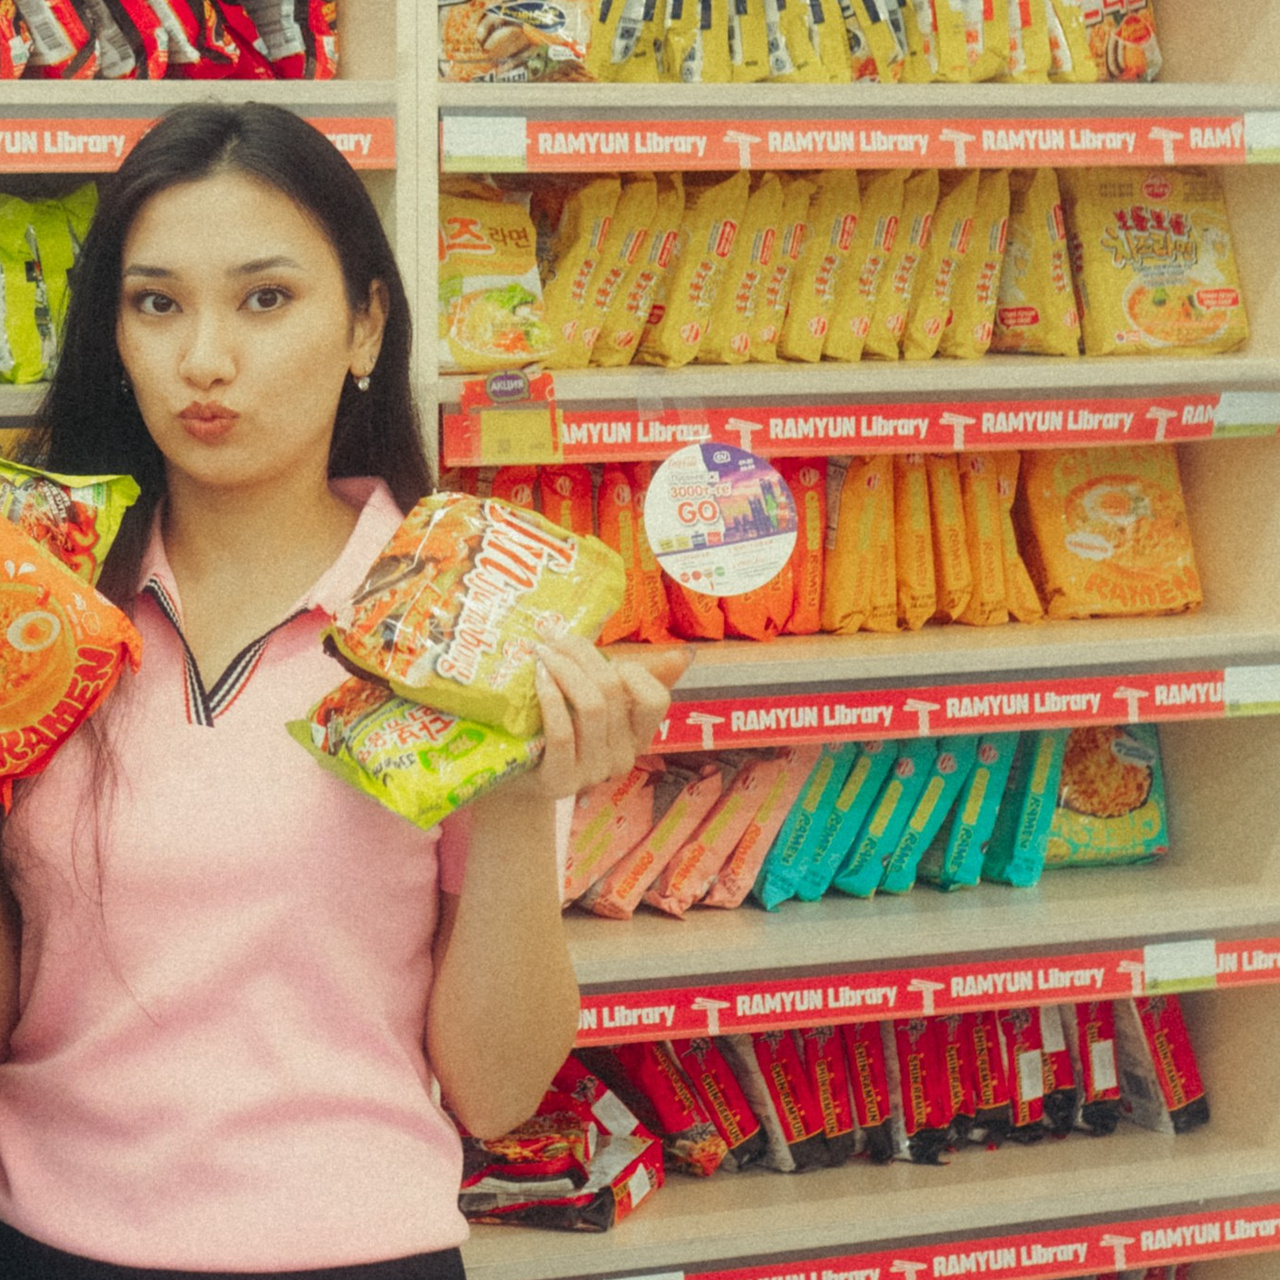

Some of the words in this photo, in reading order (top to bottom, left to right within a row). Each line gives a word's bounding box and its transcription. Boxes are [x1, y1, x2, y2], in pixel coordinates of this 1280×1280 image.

[44, 131, 125, 156] Library
[538, 133, 629, 154] RAMYUN
[635, 133, 707, 157] Library
[768, 131, 854, 152] RAMYUN
[859, 131, 929, 155] Library
[982, 130, 1065, 150] RAMYUN
[1069, 129, 1136, 152] Library
[1190, 125, 1243, 148] RAMY
[489, 226, 532, 249] 라면
[769, 417, 855, 439] RAMYUN
[860, 416, 929, 438] Library
[981, 410, 1065, 433] RAMYUN
[1068, 410, 1134, 431] Library
[561, 422, 631, 444] AMYUN
[637, 422, 712, 446] Library
[677, 499, 719, 525] GO
[946, 694, 1029, 718] RAMYUN
[1034, 692, 1100, 713] Library
[1155, 682, 1224, 705] RAMYU
[731, 707, 818, 731] RAMYUN
[823, 705, 894, 726] Library
[950, 971, 1033, 997] RAMYUN
[1038, 968, 1104, 989] Library
[737, 988, 823, 1016] RAMYUN
[828, 987, 897, 1008] Library
[602, 1006, 675, 1027] Library
[1140, 1222, 1223, 1250] RAMYUN
[932, 1248, 1016, 1276] RAMYUN
[1021, 1243, 1087, 1266] Library
